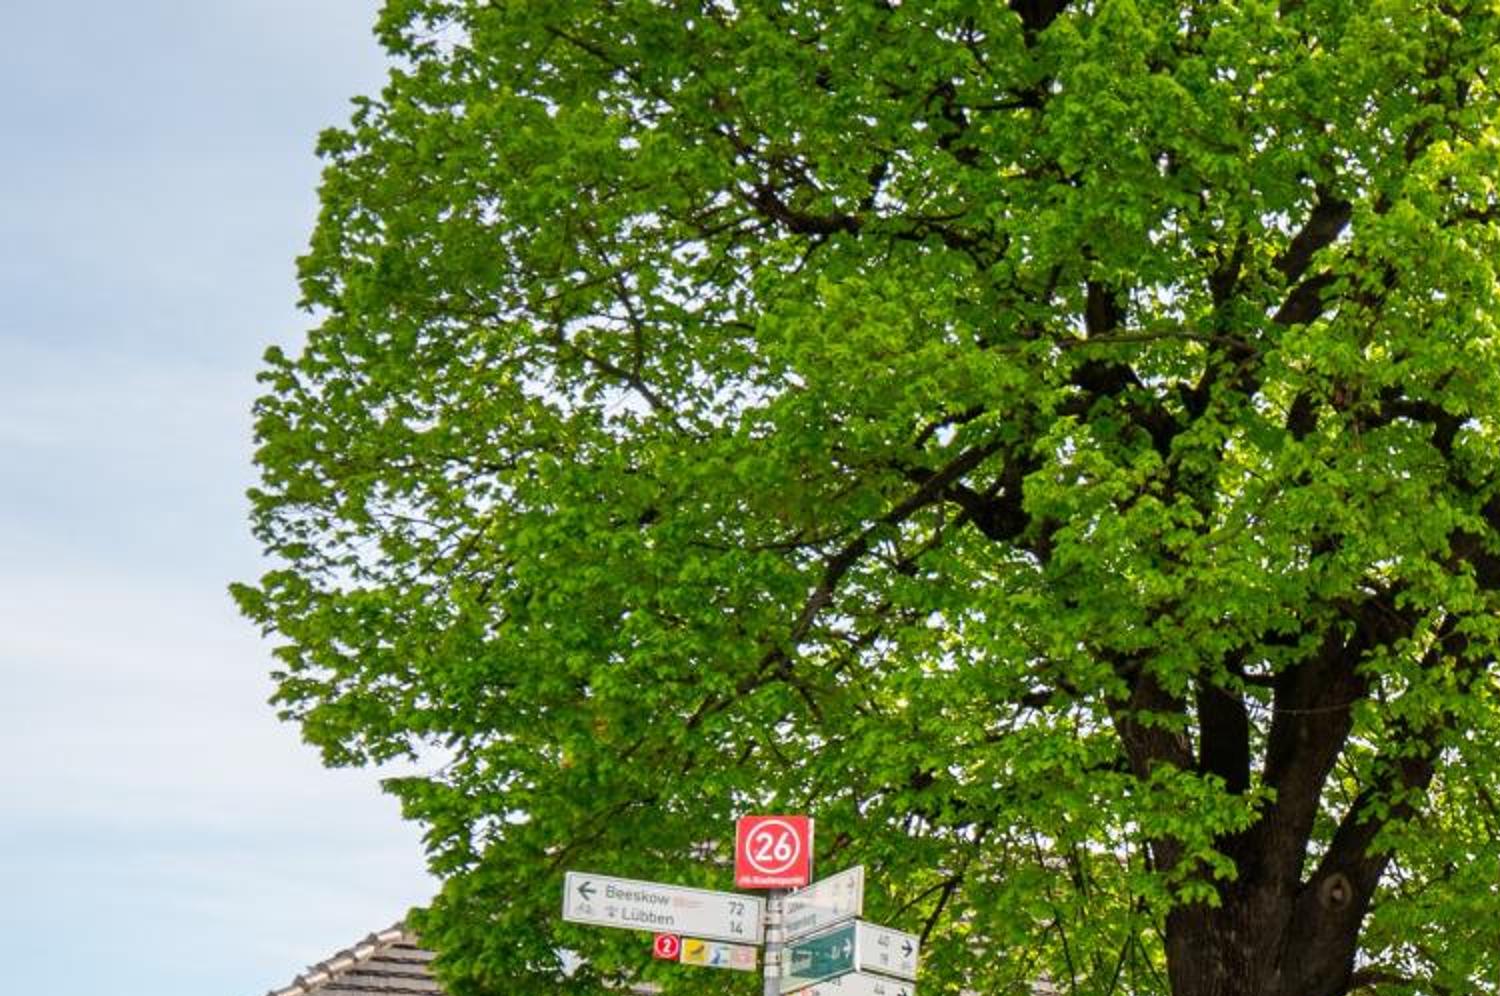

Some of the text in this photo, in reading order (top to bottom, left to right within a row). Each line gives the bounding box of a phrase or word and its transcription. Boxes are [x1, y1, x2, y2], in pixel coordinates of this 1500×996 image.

[755, 831, 792, 861] 26
[605, 884, 745, 916] Beeskow 72
[621, 906, 743, 935] Lübben 14
